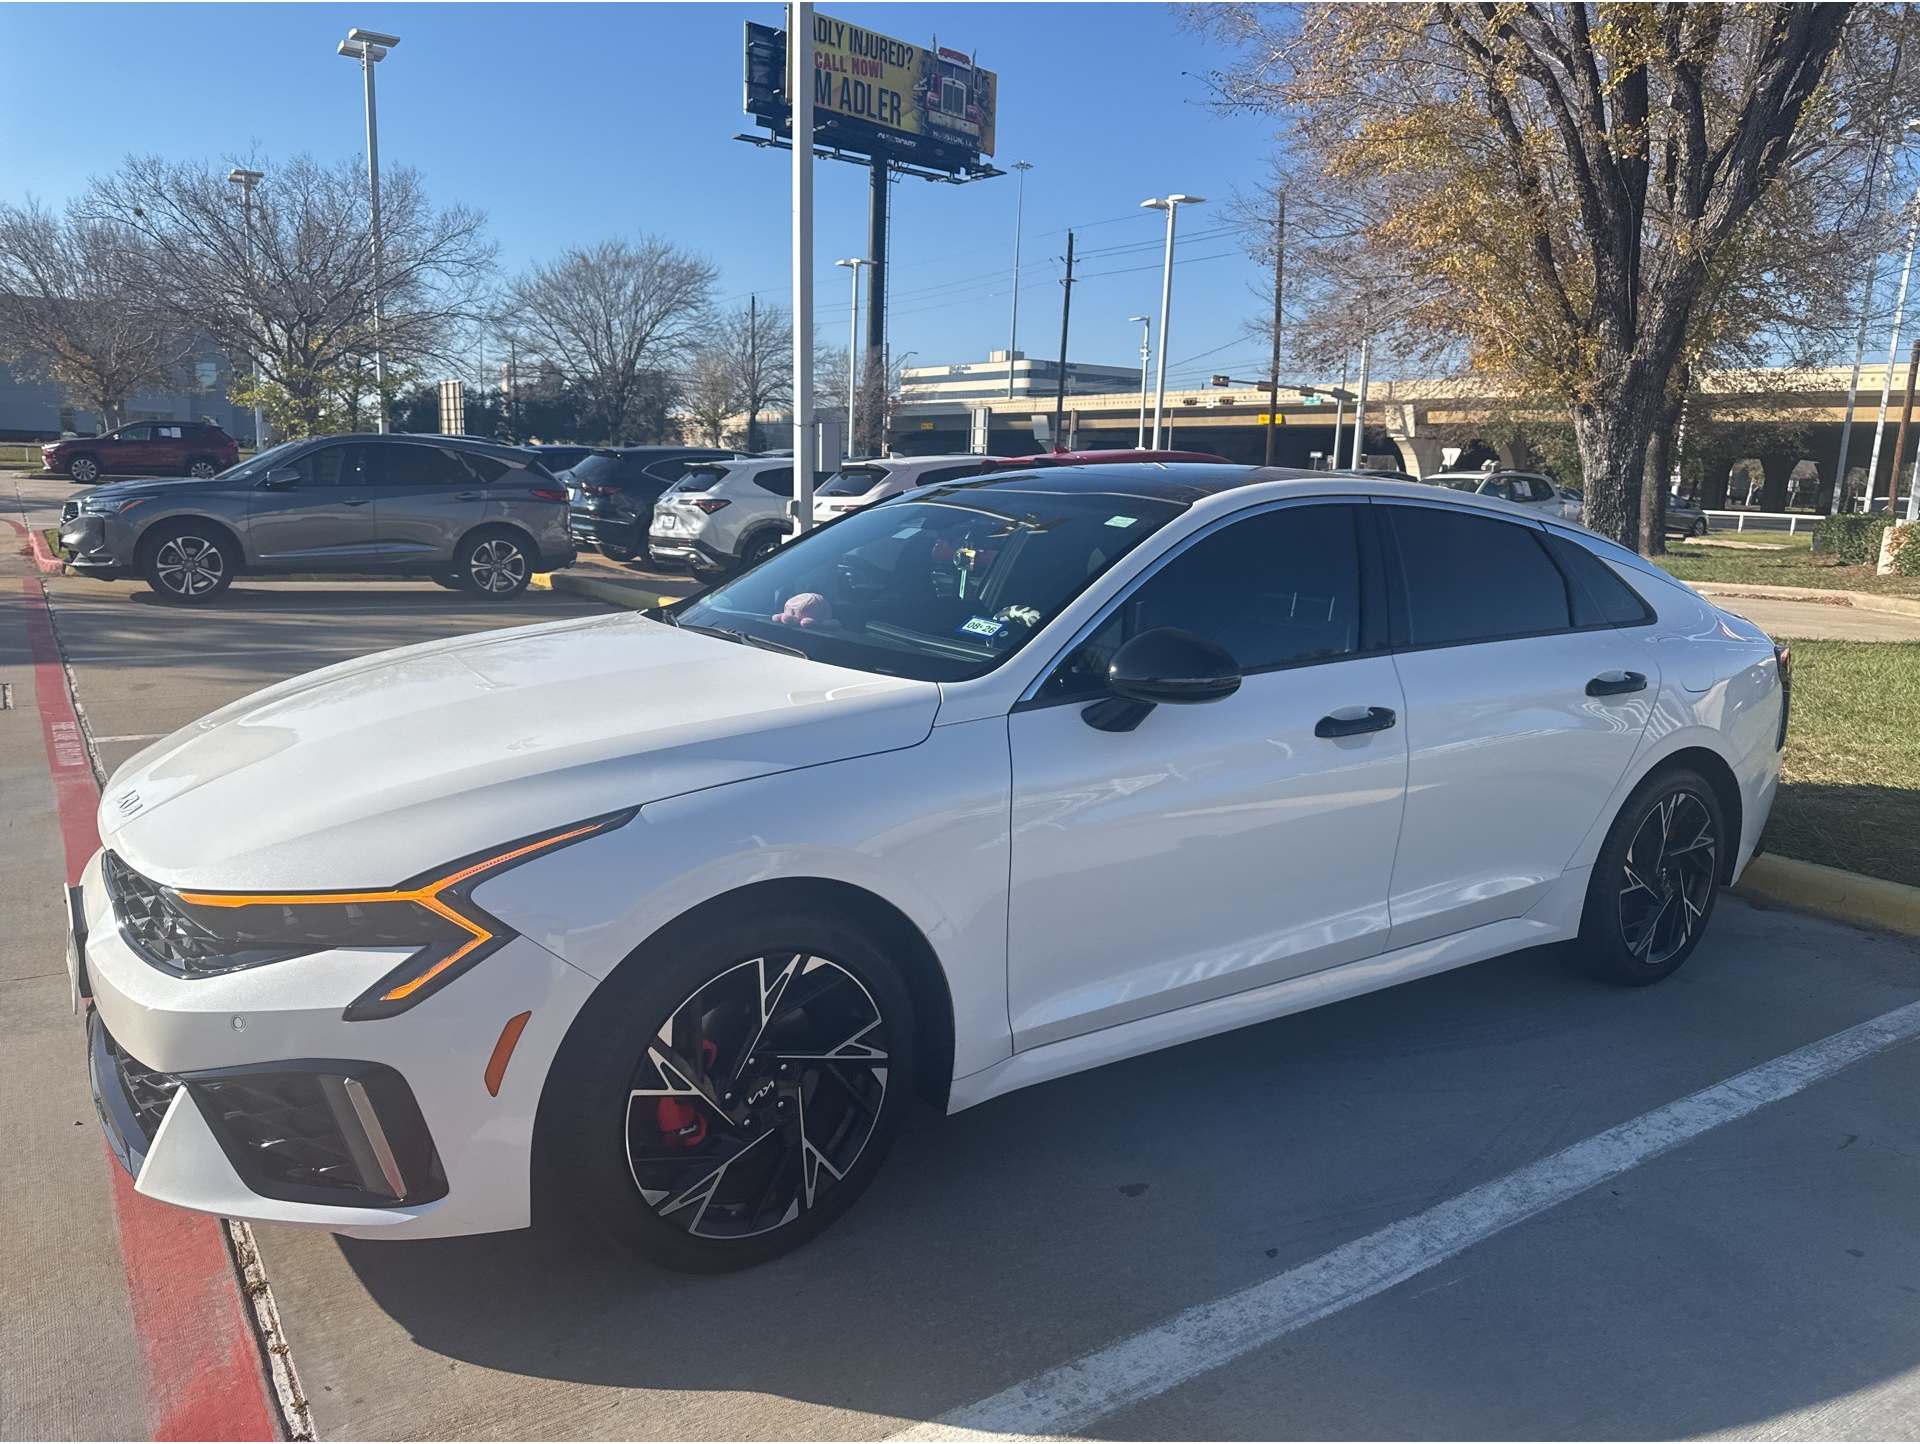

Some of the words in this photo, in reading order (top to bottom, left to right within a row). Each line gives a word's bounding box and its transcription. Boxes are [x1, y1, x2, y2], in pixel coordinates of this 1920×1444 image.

[814, 51, 847, 73] CALL
[851, 57, 883, 79] NOW!
[848, 27, 914, 70] INJURED?
[840, 76, 902, 127] ADLER
